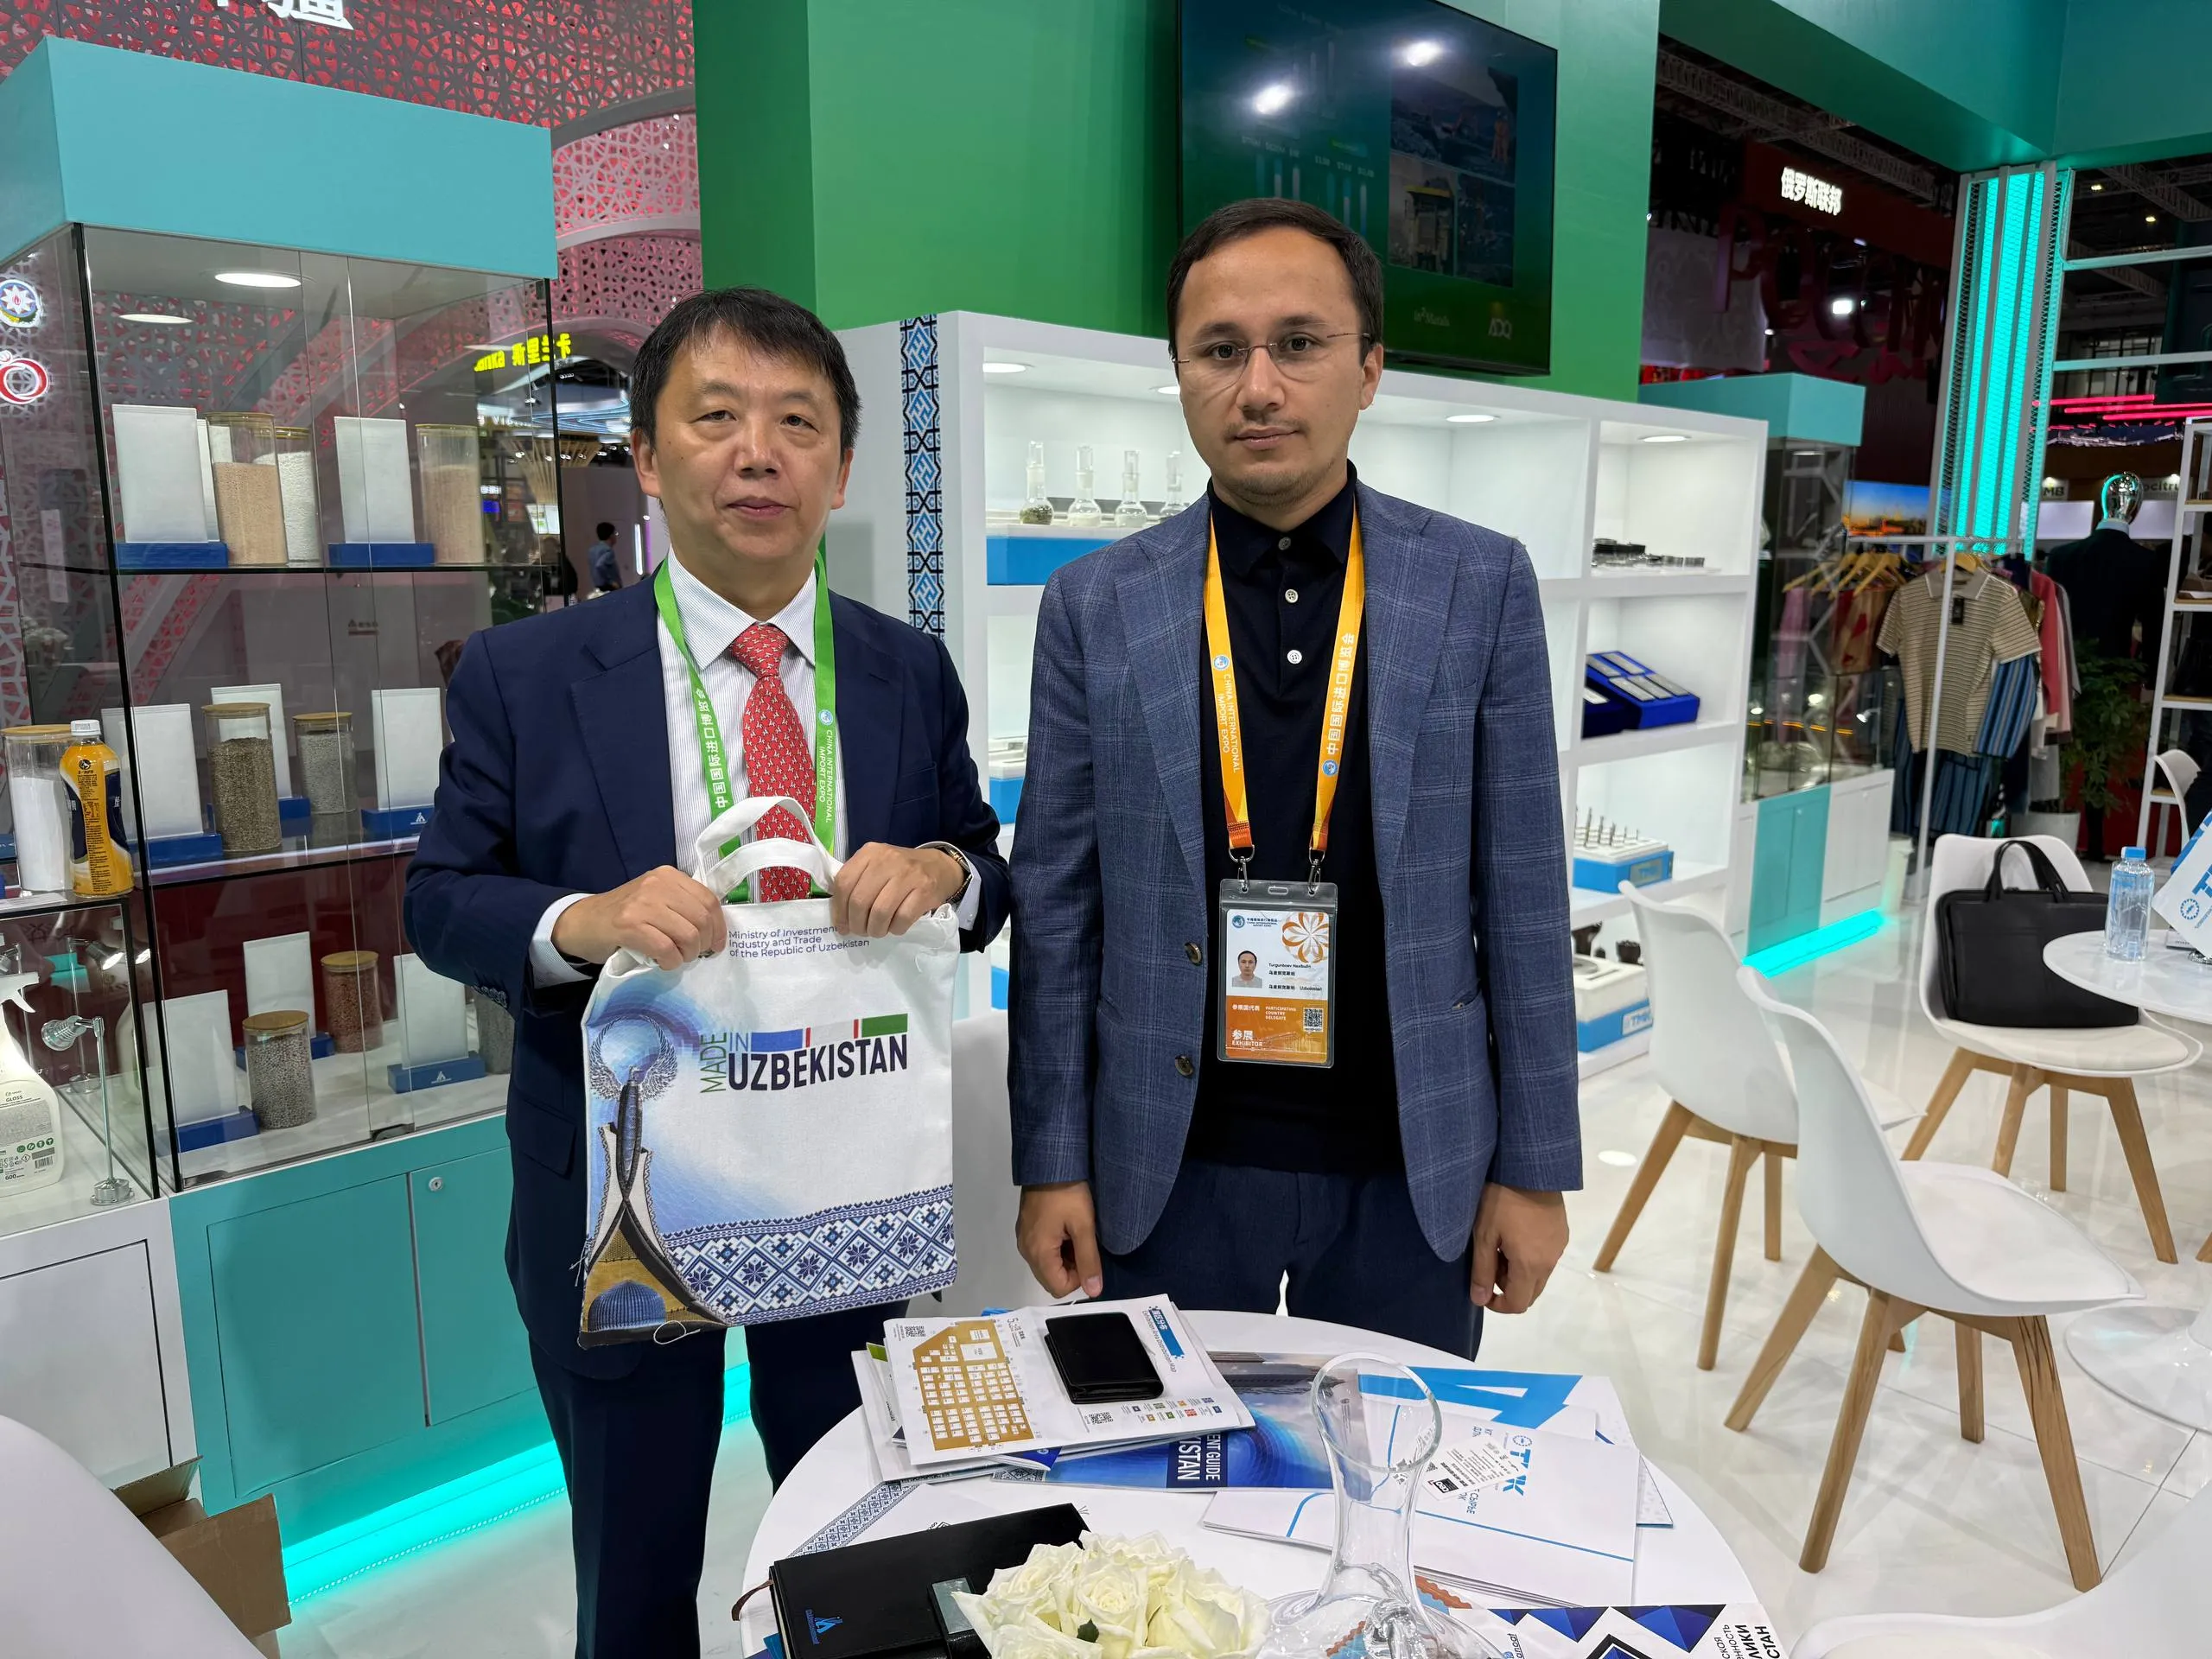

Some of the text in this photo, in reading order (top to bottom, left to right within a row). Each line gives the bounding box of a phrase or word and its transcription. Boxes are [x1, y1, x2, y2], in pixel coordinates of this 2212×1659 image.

[1782, 167, 1842, 215] 俄罗斯联邦
[1326, 632, 1355, 755] 中国国际进口博览会
[696, 688, 728, 809] 中国国际进口博览会
[1217, 694, 1230, 753] IMPORT EXPO
[1224, 674, 1240, 773] CHINA INTERNATIONAL
[825, 758, 834, 823] INTERNATIONAL
[728, 930, 768, 939] Ministry
[770, 929, 780, 938] of
[728, 936, 822, 949] Industry and Trade
[729, 938, 870, 958] of the Republic of Uzbekistan
[1232, 1029, 1254, 1041] 参展
[700, 1032, 749, 1094] MADE IN
[728, 1033, 908, 1091] UZBEKISTAN
[1205, 1452, 1221, 1481] GUIDE
[1754, 1626, 1781, 1659] СТАН
